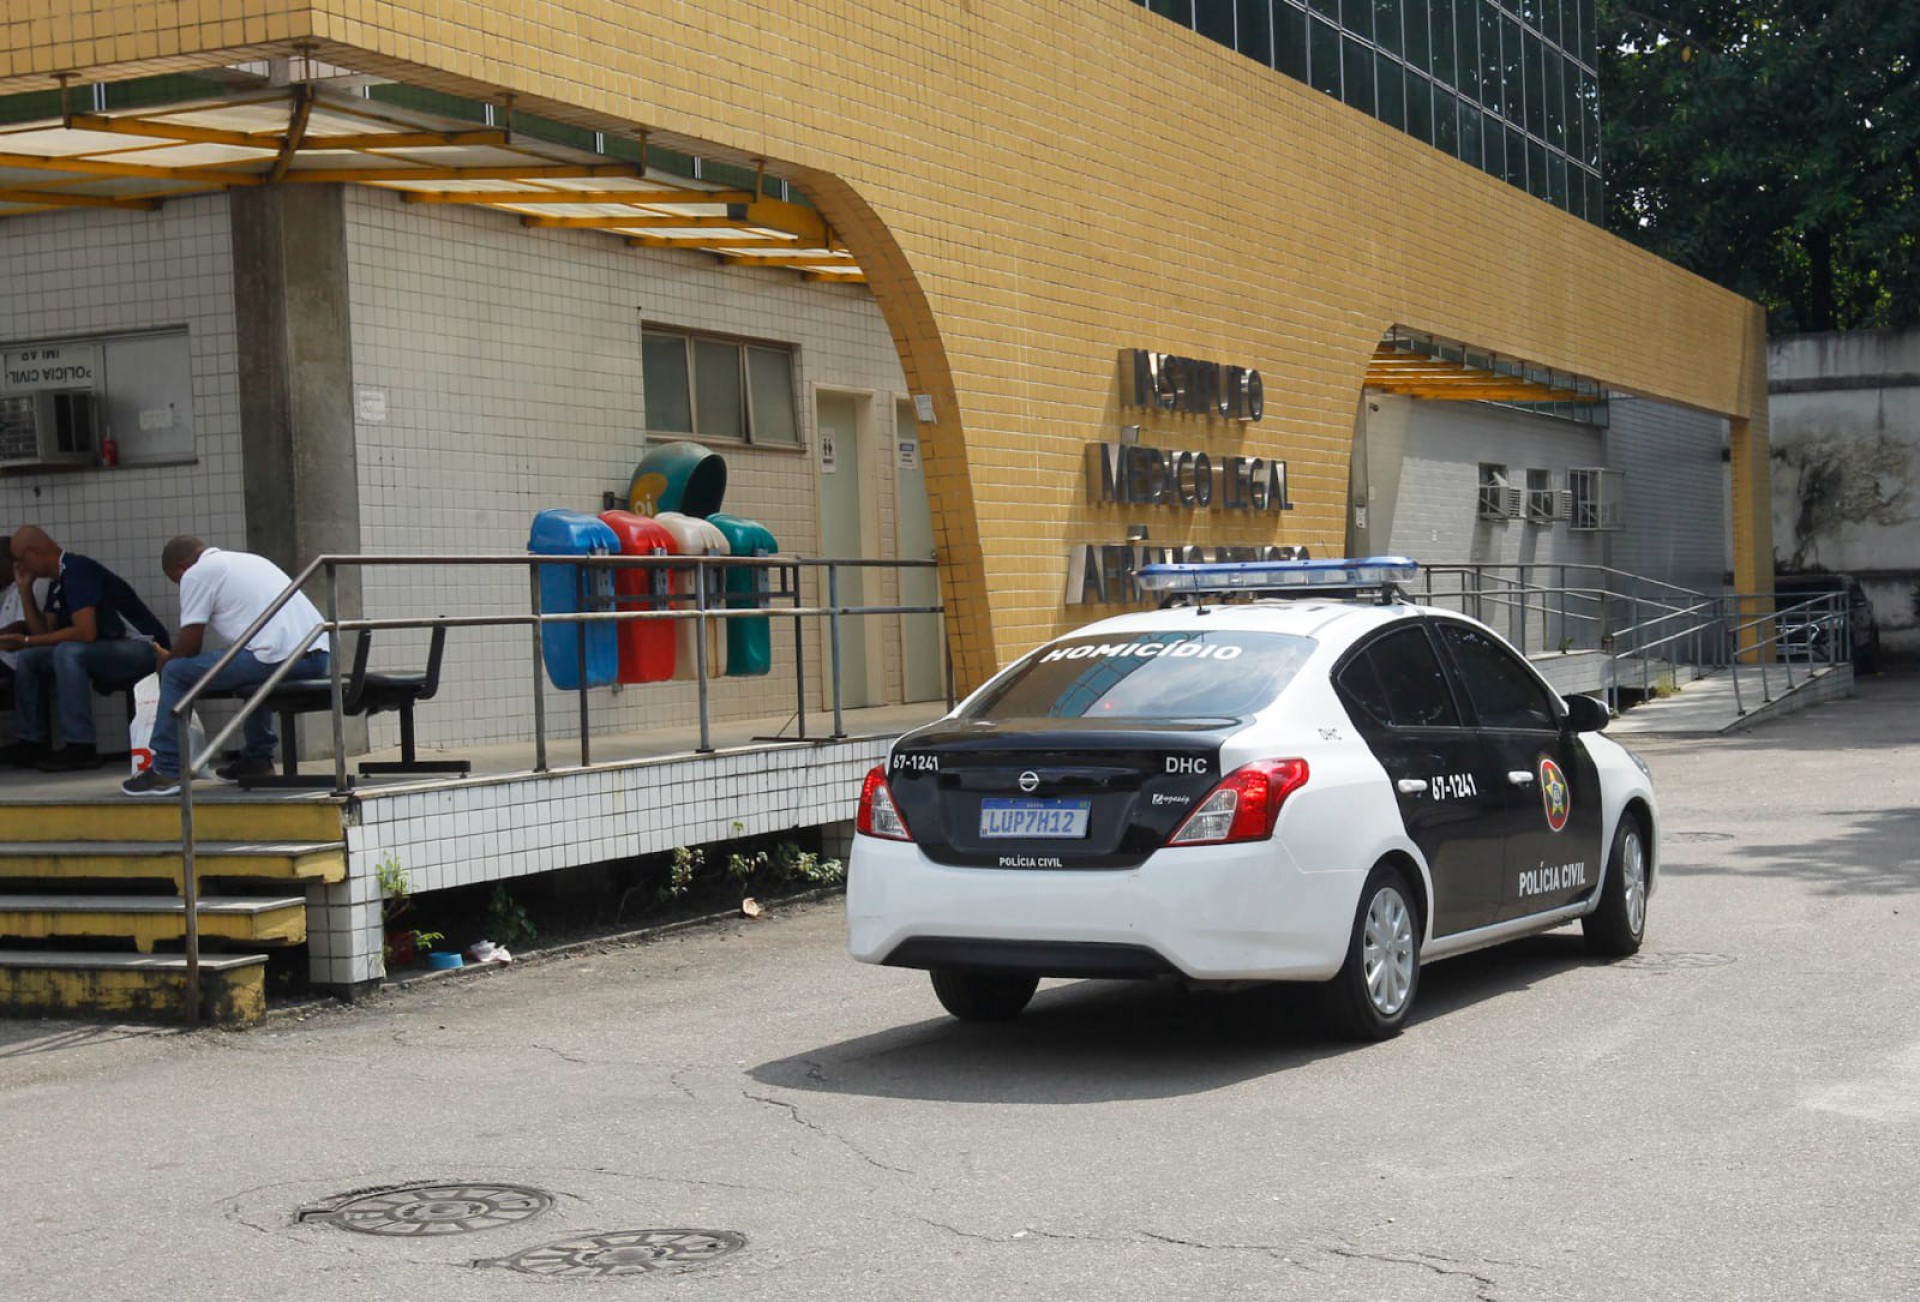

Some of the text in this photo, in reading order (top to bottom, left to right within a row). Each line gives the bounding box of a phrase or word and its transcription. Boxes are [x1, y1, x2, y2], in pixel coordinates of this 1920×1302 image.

[1039, 640, 1242, 663] HOMICÍDIO
[893, 754, 939, 771] 67-1241
[1165, 756, 1208, 774] DHC
[1432, 773, 1477, 801] 67-1241
[989, 811, 1075, 833] LUP7H12
[1000, 854, 1063, 868] POLÍCIA CIVIL
[1519, 861, 1586, 897] POLÍCIA CIVIL
